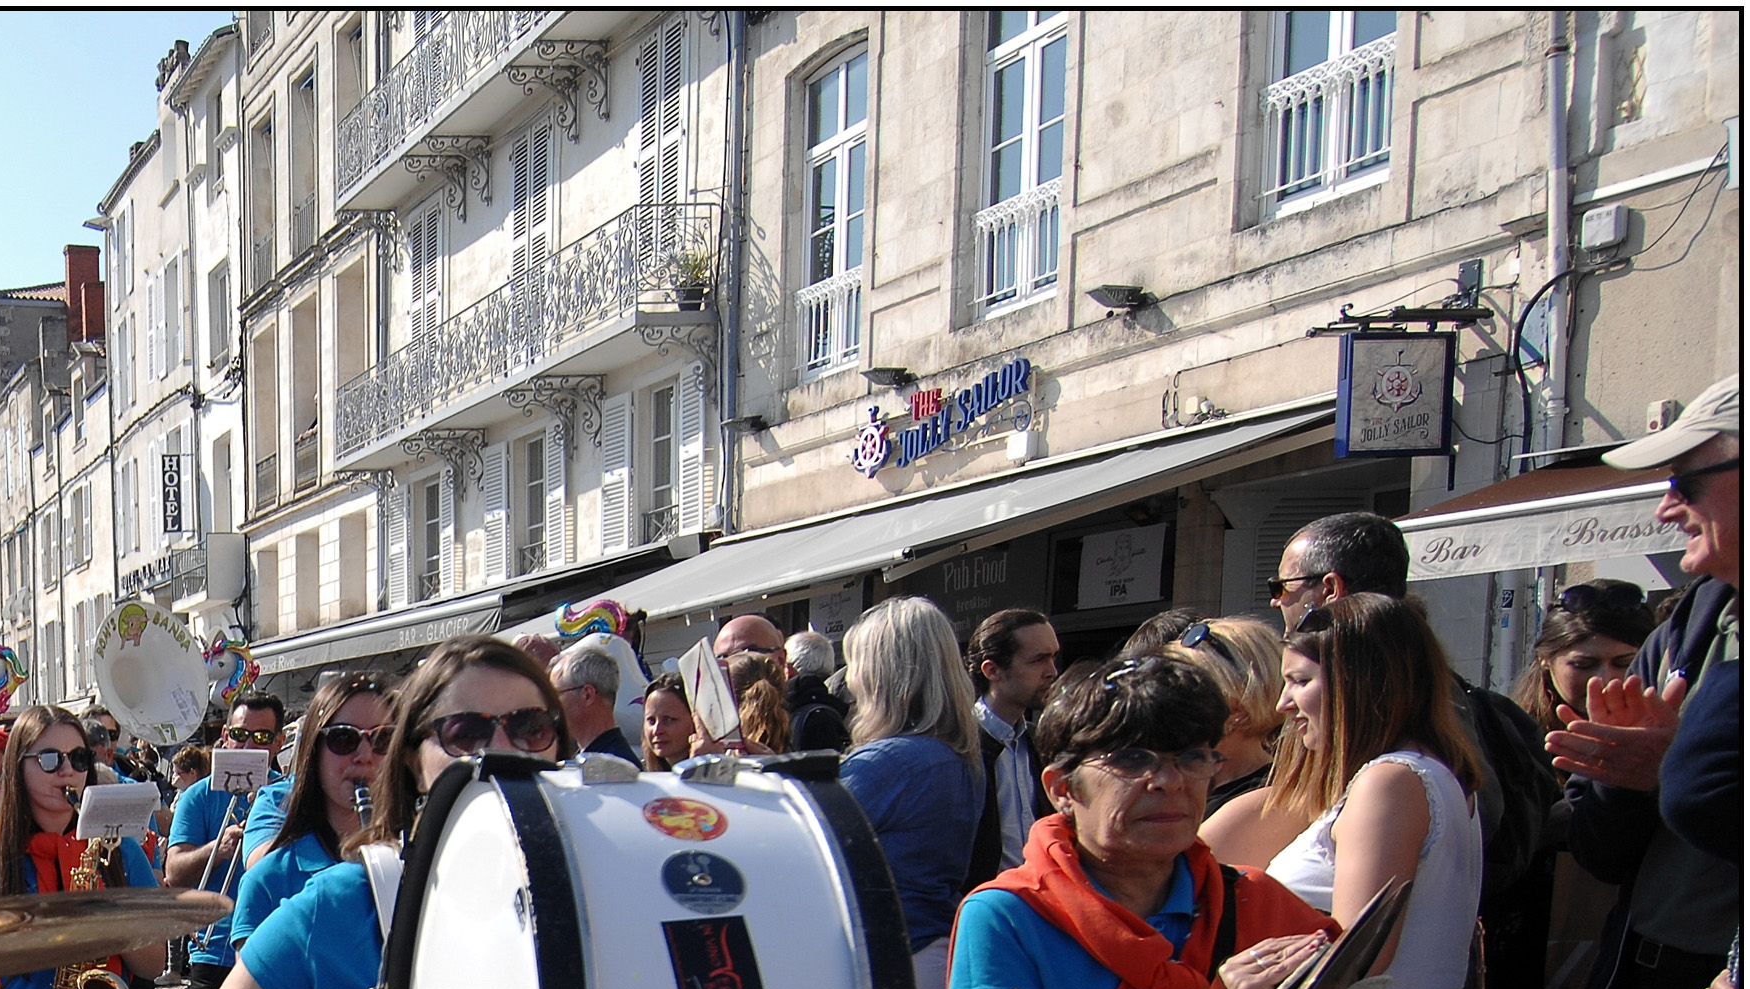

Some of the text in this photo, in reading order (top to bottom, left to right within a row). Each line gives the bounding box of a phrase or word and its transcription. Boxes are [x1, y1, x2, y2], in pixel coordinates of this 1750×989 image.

[896, 358, 1032, 468] JOLLY SAILOR
[909, 387, 942, 421] THE
[1360, 413, 1430, 443] JOLLY SAILOR
[163, 455, 179, 531] HOTEL
[1420, 515, 1677, 565] Bar Brasse
[942, 551, 1008, 594] Pub Food
[956, 596, 992, 613] Breakfast
[1109, 584, 1128, 597] IPA
[152, 610, 191, 653] BANDA
[400, 630, 417, 648] BAR
[426, 617, 470, 642] GLACIER
[153, 722, 178, 744] 17
